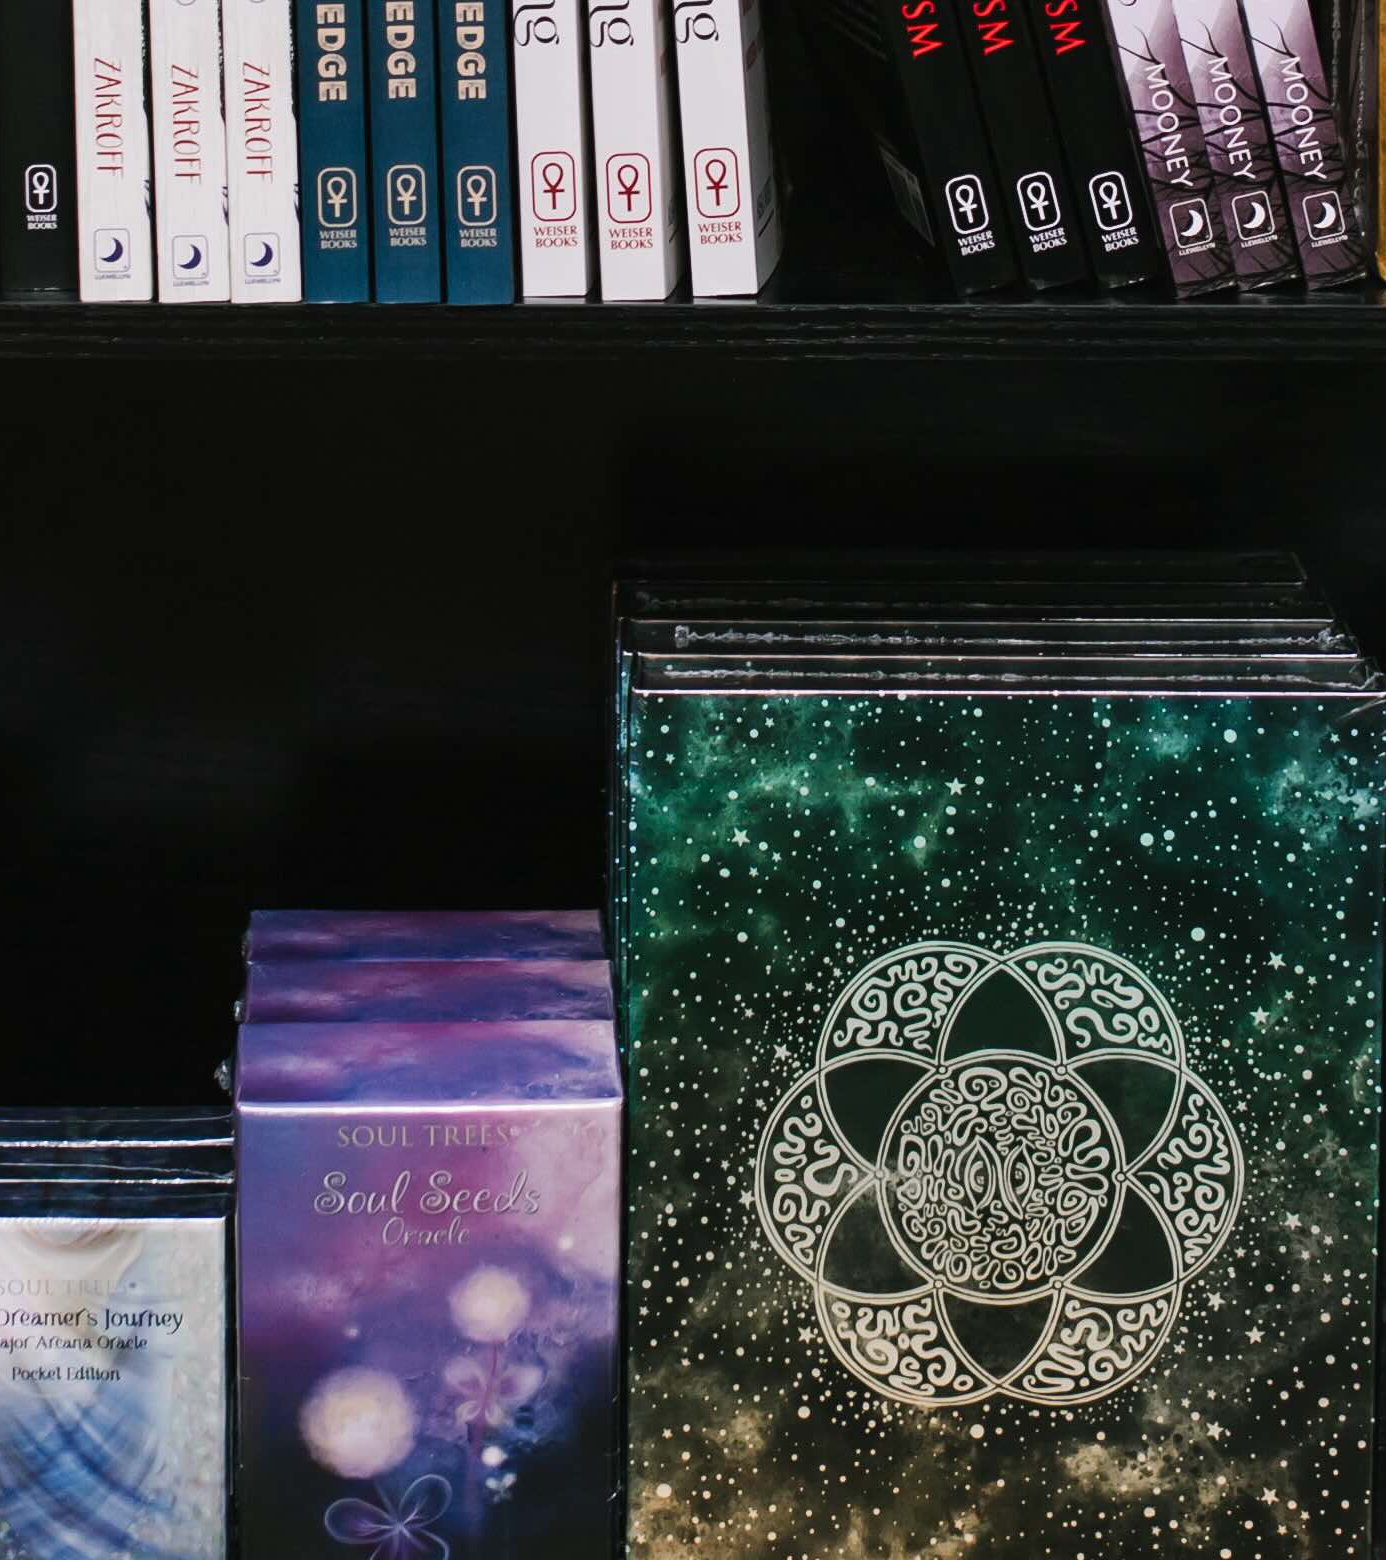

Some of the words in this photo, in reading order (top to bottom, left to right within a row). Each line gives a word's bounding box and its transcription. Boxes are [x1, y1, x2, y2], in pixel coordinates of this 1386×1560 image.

[1278, 54, 1325, 182] MOONEY
[533, 225, 578, 236] WEISER
[535, 237, 578, 248] BOOKS
[12, 1365, 60, 1382] Pocket
[66, 1365, 120, 1382] Edition
